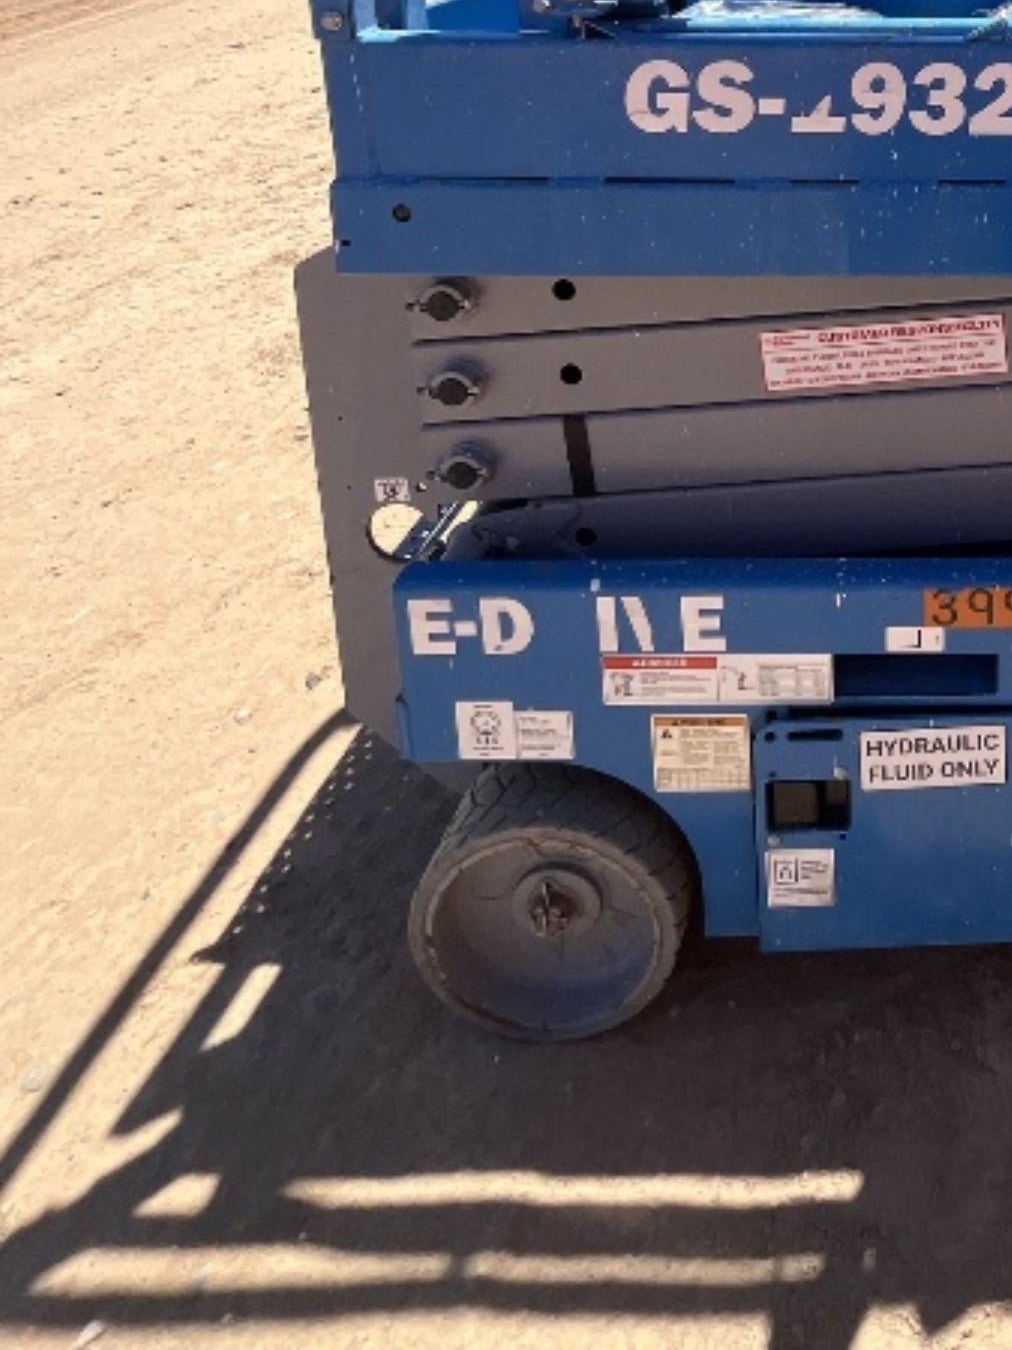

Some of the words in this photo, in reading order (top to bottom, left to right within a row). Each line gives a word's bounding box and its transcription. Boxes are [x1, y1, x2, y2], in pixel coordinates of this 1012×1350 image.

[865, 733, 1001, 758] HYDRAULIC
[868, 765, 935, 783] FLUID
[941, 758, 1001, 779] ONLY
